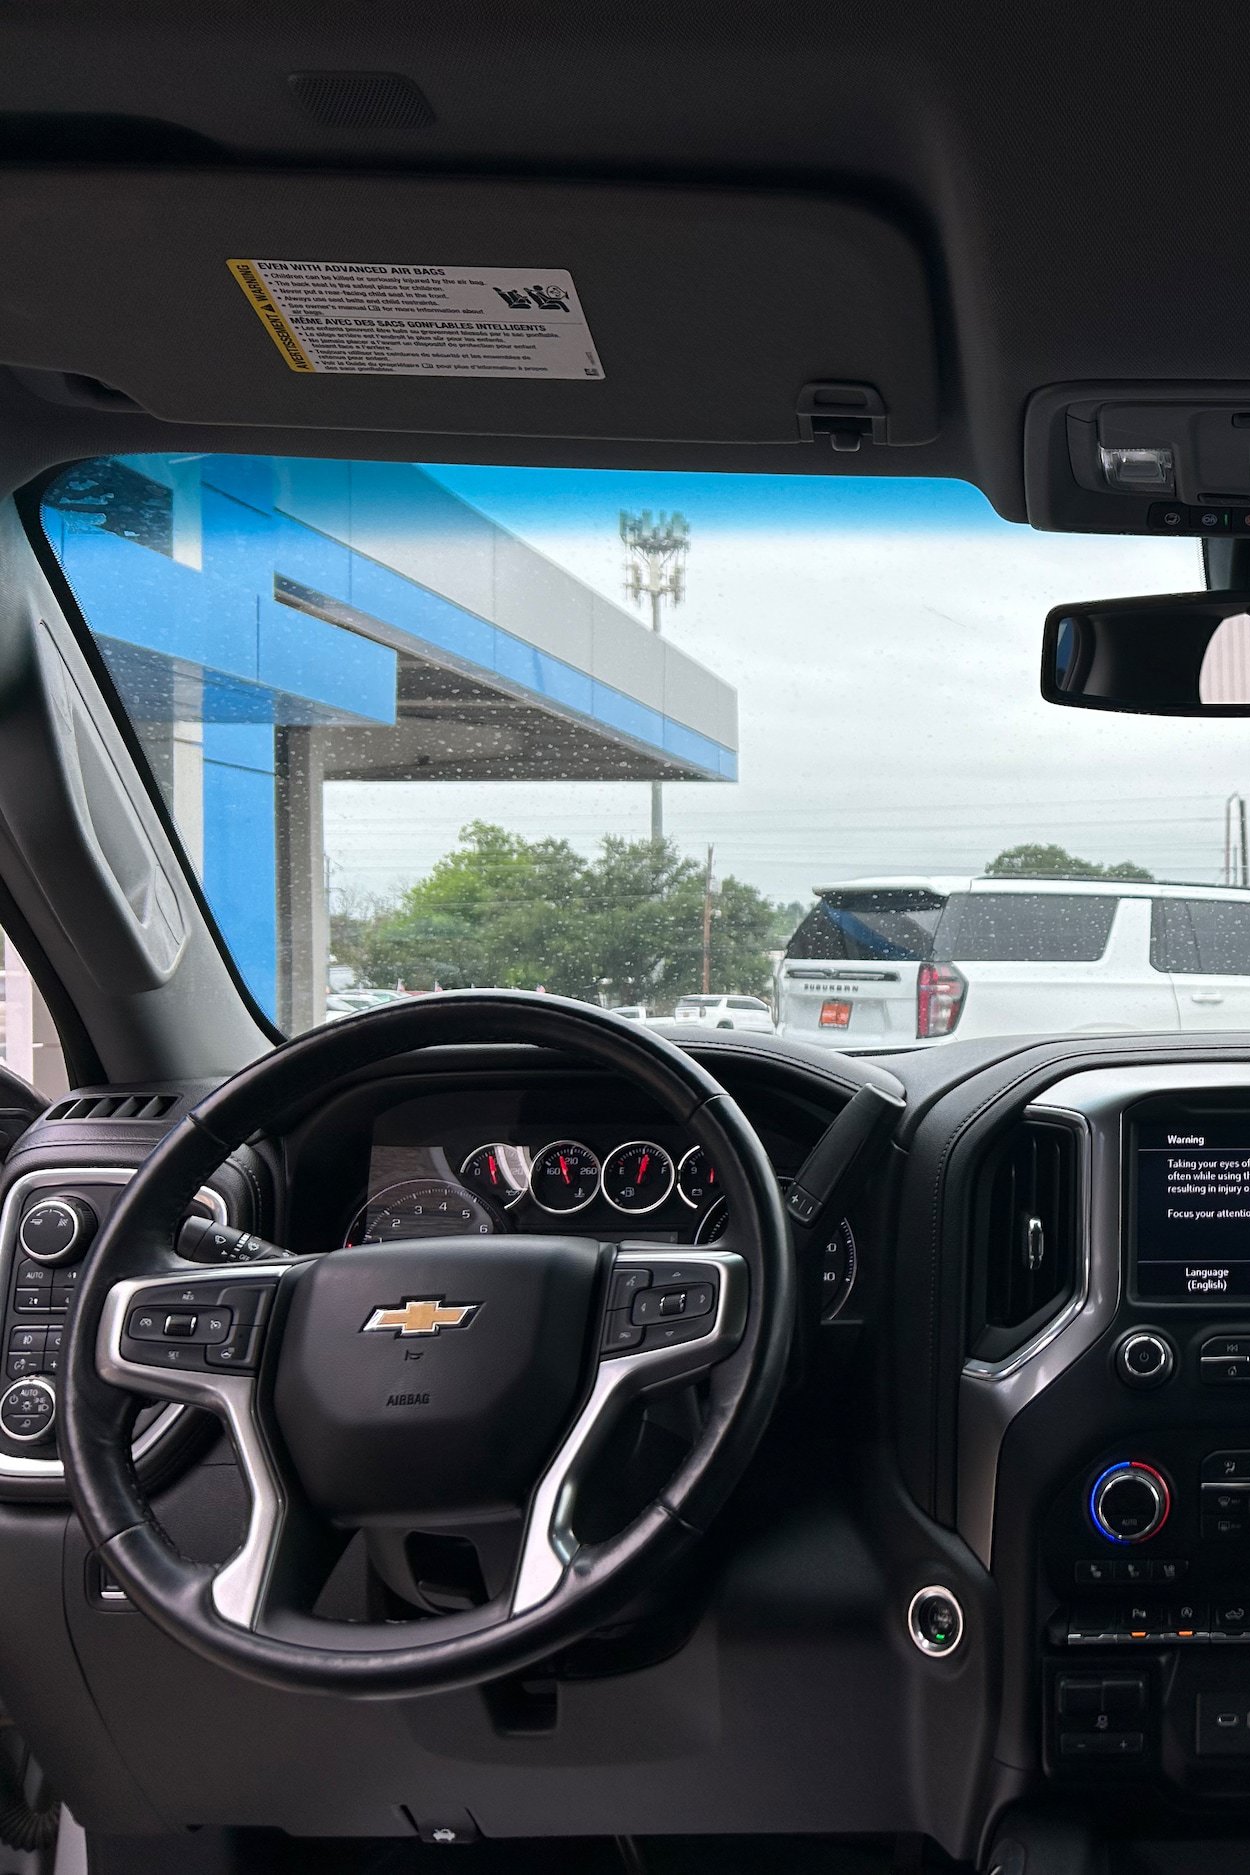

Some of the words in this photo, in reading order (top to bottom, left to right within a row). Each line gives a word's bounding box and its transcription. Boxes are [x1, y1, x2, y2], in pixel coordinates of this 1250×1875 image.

[257, 262, 289, 270] EVEN
[290, 264, 322, 272] WITH
[325, 265, 388, 274] ADVANCED
[413, 268, 446, 276] BAGS
[237, 265, 268, 302] WARNING
[326, 318, 352, 326] AVEC
[376, 320, 406, 328] SACS
[407, 321, 474, 330] GONFLABLES
[476, 323, 546, 332] INTELLIGENTS
[804, 983, 859, 993] SUBURBAN
[1168, 1134, 1205, 1146] Warning
[1168, 1159, 1196, 1170] Taking
[1198, 1161, 1217, 1170] your
[1220, 1161, 1239, 1170] eyes
[619, 1166, 624, 1175] E
[1168, 1171, 1191, 1181] often
[1193, 1171, 1216, 1181] while
[1218, 1172, 1241, 1182] using
[1168, 1184, 1206, 1195] resulting
[1208, 1184, 1216, 1193] in
[1218, 1184, 1242, 1195] injury
[415, 1206, 422, 1214] 3
[440, 1202, 447, 1210] 4
[462, 1210, 470, 1218] 5
[1168, 1209, 1194, 1218] Focus
[1196, 1211, 1214, 1220] your
[392, 1219, 400, 1227] 2
[480, 1224, 488, 1233] 6
[1186, 1267, 1230, 1280] Language
[1187, 1280, 1228, 1292] (English)
[20, 1388, 38, 1396] AUTO
[386, 1393, 431, 1407] AIRBAG
